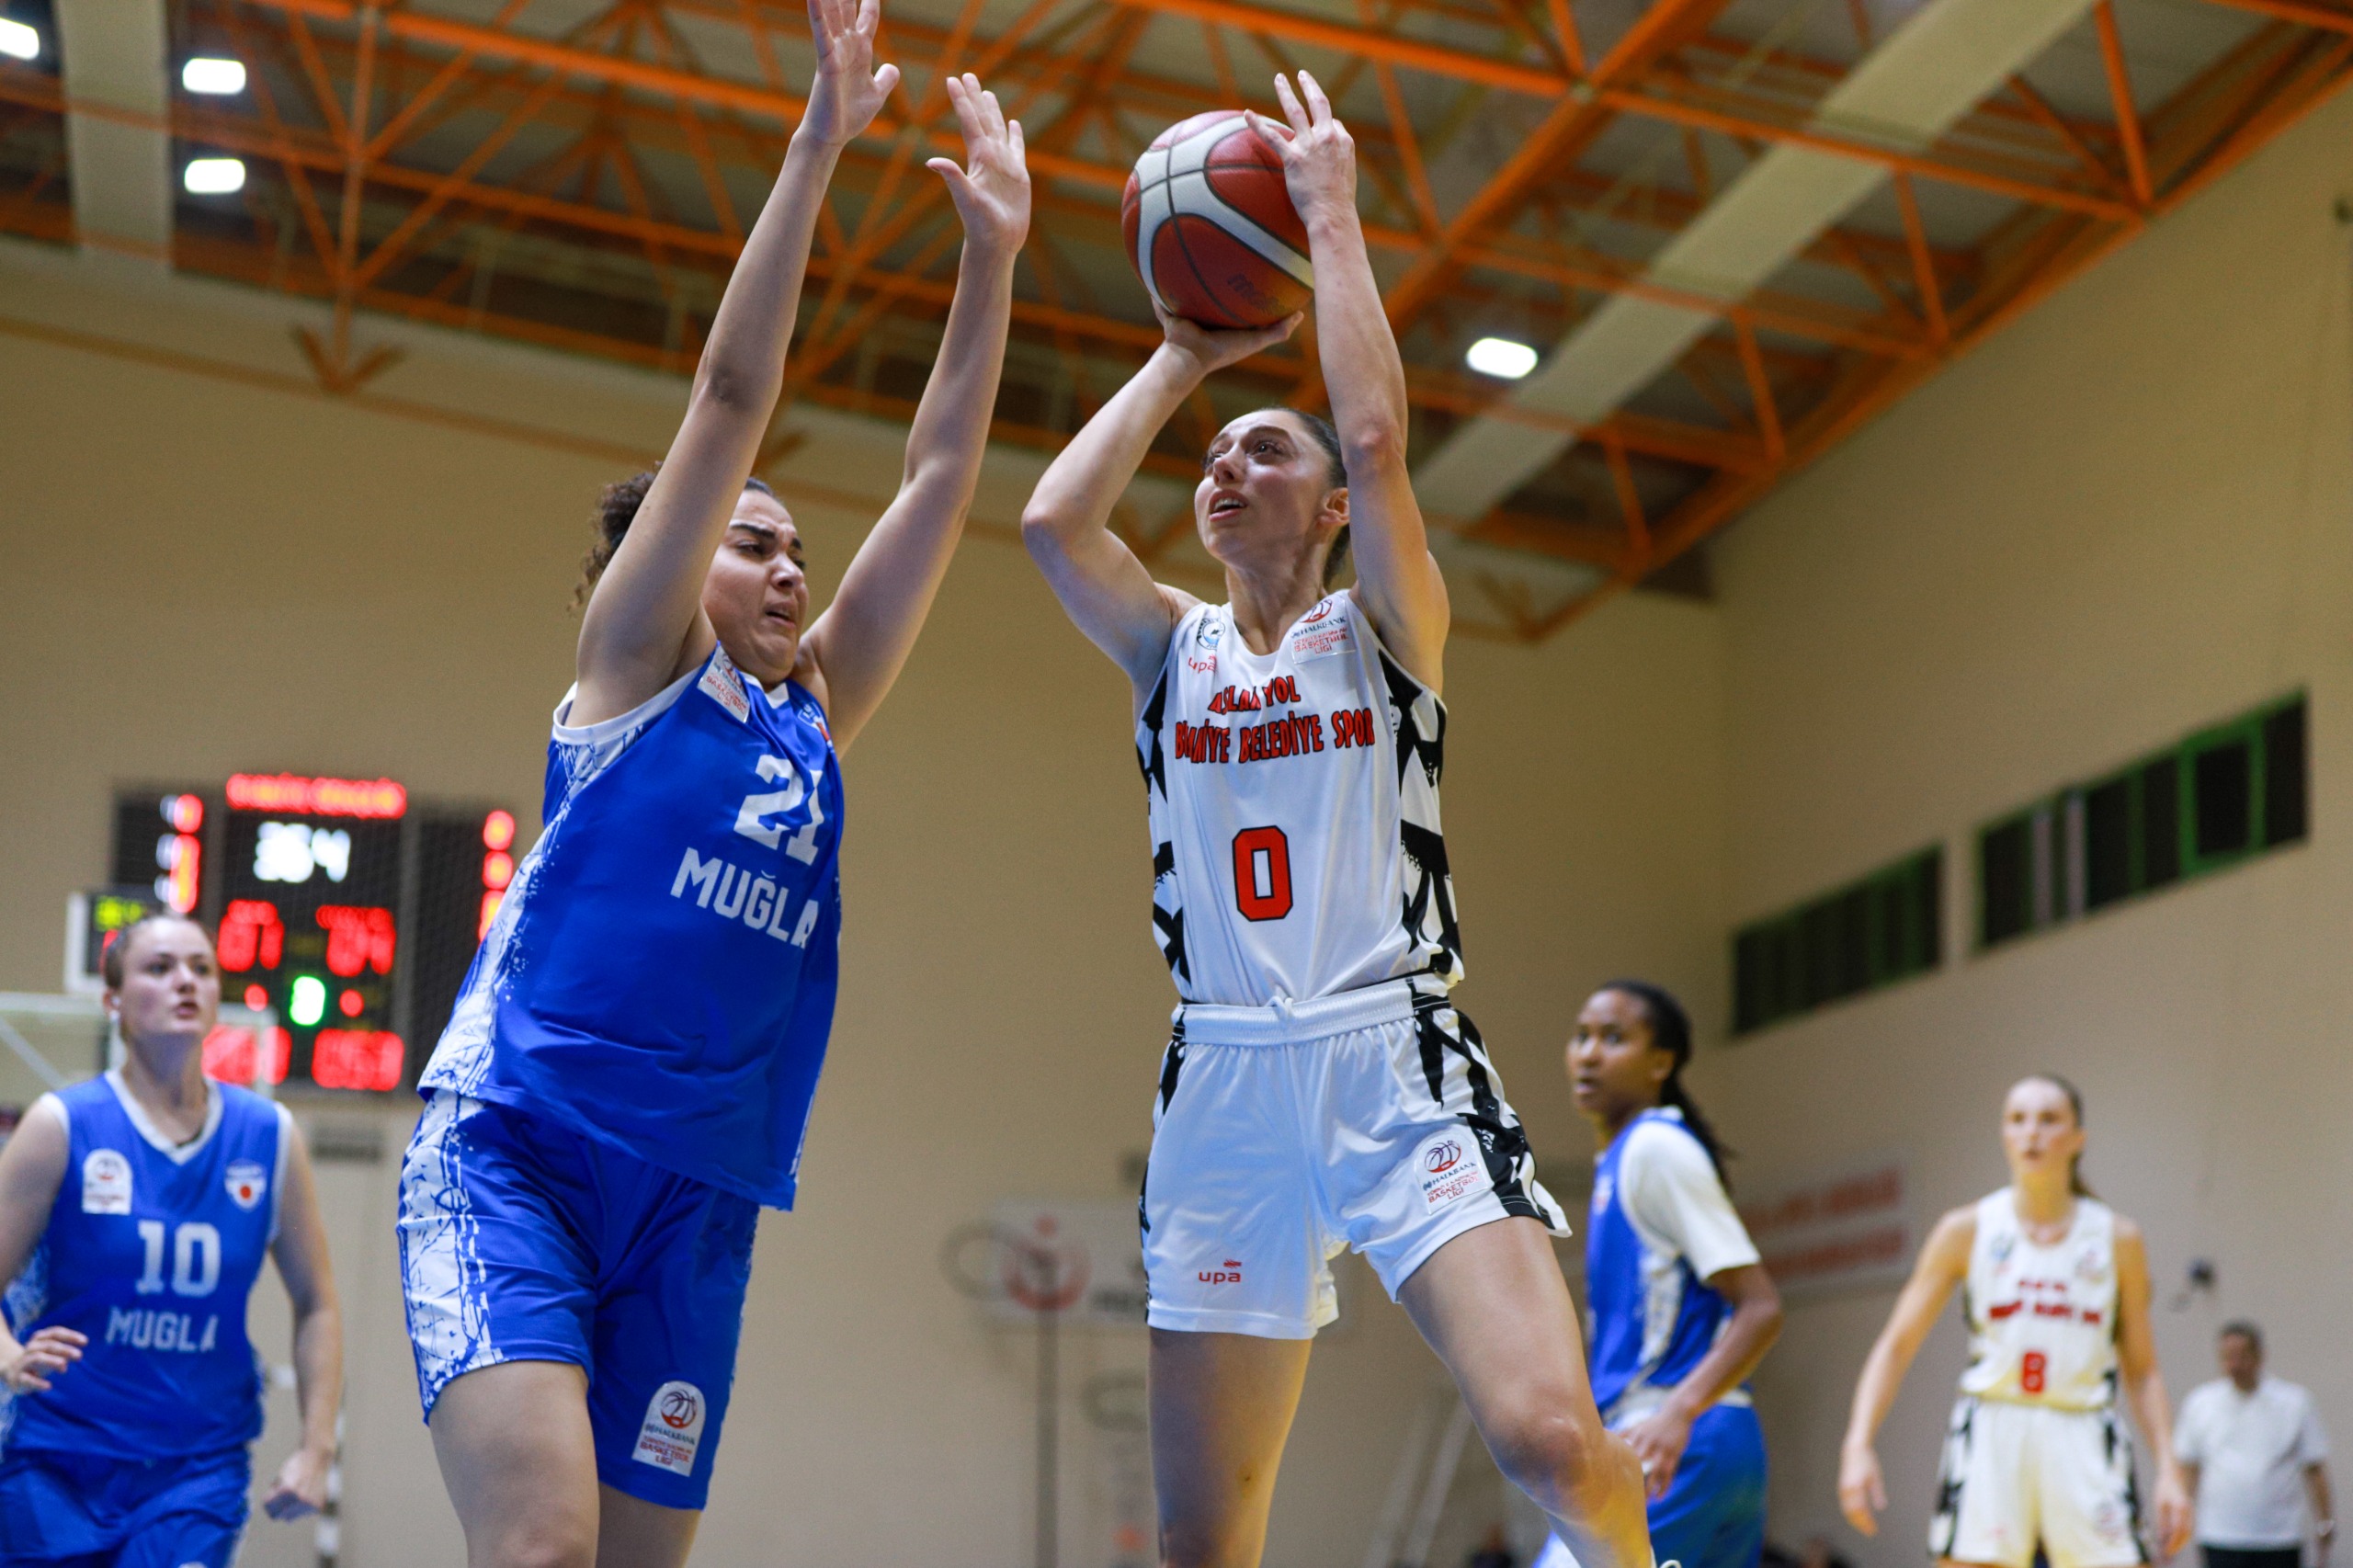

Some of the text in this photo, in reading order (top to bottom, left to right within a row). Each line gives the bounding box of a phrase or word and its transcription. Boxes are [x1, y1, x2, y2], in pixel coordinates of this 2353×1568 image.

[1238, 710, 1324, 764] BELEDİYE
[1331, 707, 1376, 749] SPOR
[734, 754, 824, 867] 21
[670, 846, 820, 950] MUĞLA
[1232, 825, 1293, 922] 0
[135, 1219, 222, 1297] 10
[1199, 1271, 1241, 1285] upa
[2021, 1351, 2047, 1395] 8
